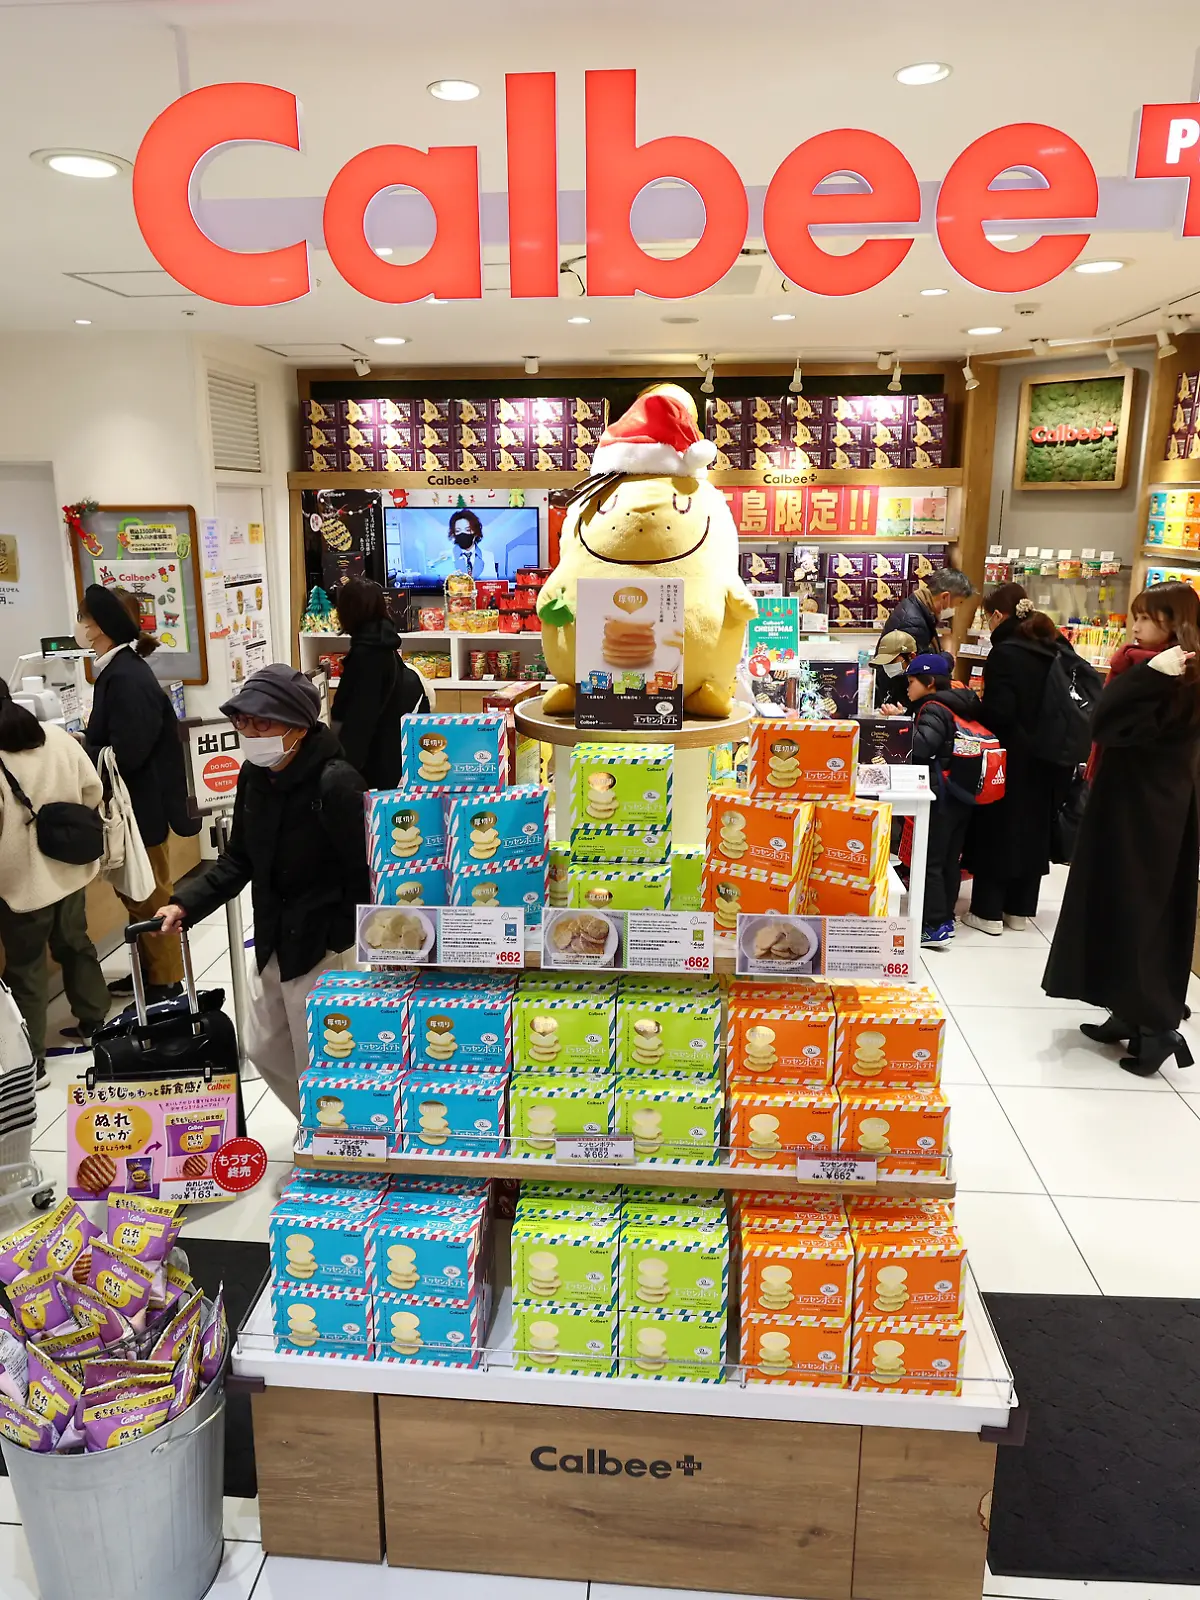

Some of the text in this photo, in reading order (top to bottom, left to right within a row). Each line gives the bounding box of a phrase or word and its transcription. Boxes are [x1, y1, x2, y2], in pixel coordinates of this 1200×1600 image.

[1166, 118, 1200, 164] P
[132, 69, 1099, 307] Calbee
[717, 487, 871, 533] 島限定!!
[198, 730, 241, 755] 出口
[210, 761, 233, 771] DO NOT
[214, 778, 233, 788] ENTER
[496, 951, 521, 962] ¥662
[684, 956, 710, 968] ¥662
[883, 963, 909, 974] ¥662
[207, 1082, 231, 1092] Calbee
[94, 1113, 131, 1128] ぬれ
[96, 1129, 132, 1141] じゃが
[339, 1149, 363, 1157] ¥662
[584, 1151, 609, 1159] ¥662
[219, 1153, 261, 1167] もうすぐ
[227, 1166, 252, 1178] 終売
[826, 1172, 851, 1180] ¥662
[183, 1190, 211, 1199] ¥163
[111, 1264, 128, 1279] Calbee
[173, 1323, 188, 1341] Calbee
[5, 1411, 21, 1425] Calbee
[121, 1413, 144, 1425] Calbee
